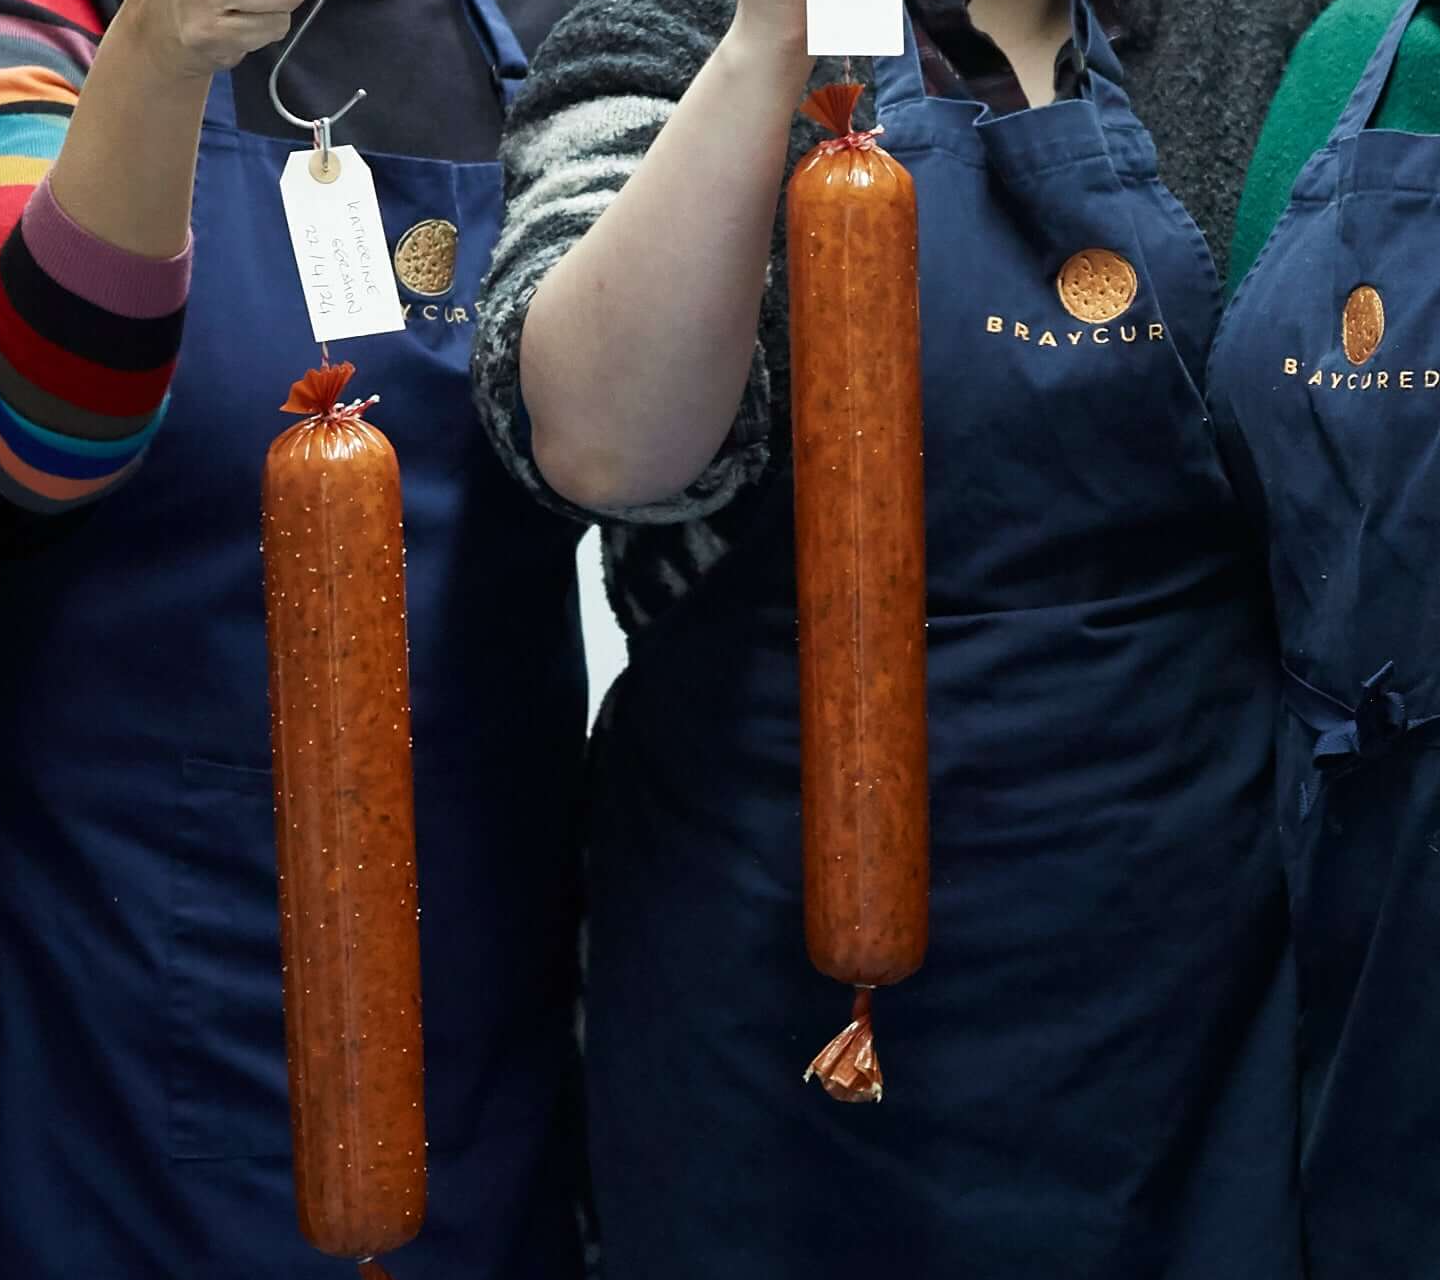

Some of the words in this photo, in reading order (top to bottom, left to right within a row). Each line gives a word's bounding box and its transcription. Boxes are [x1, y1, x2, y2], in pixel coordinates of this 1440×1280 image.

[346, 199, 381, 297] KATHERINE
[986, 315, 1165, 347] BRAYCUR
[1284, 357, 1440, 390] BAYCURED
